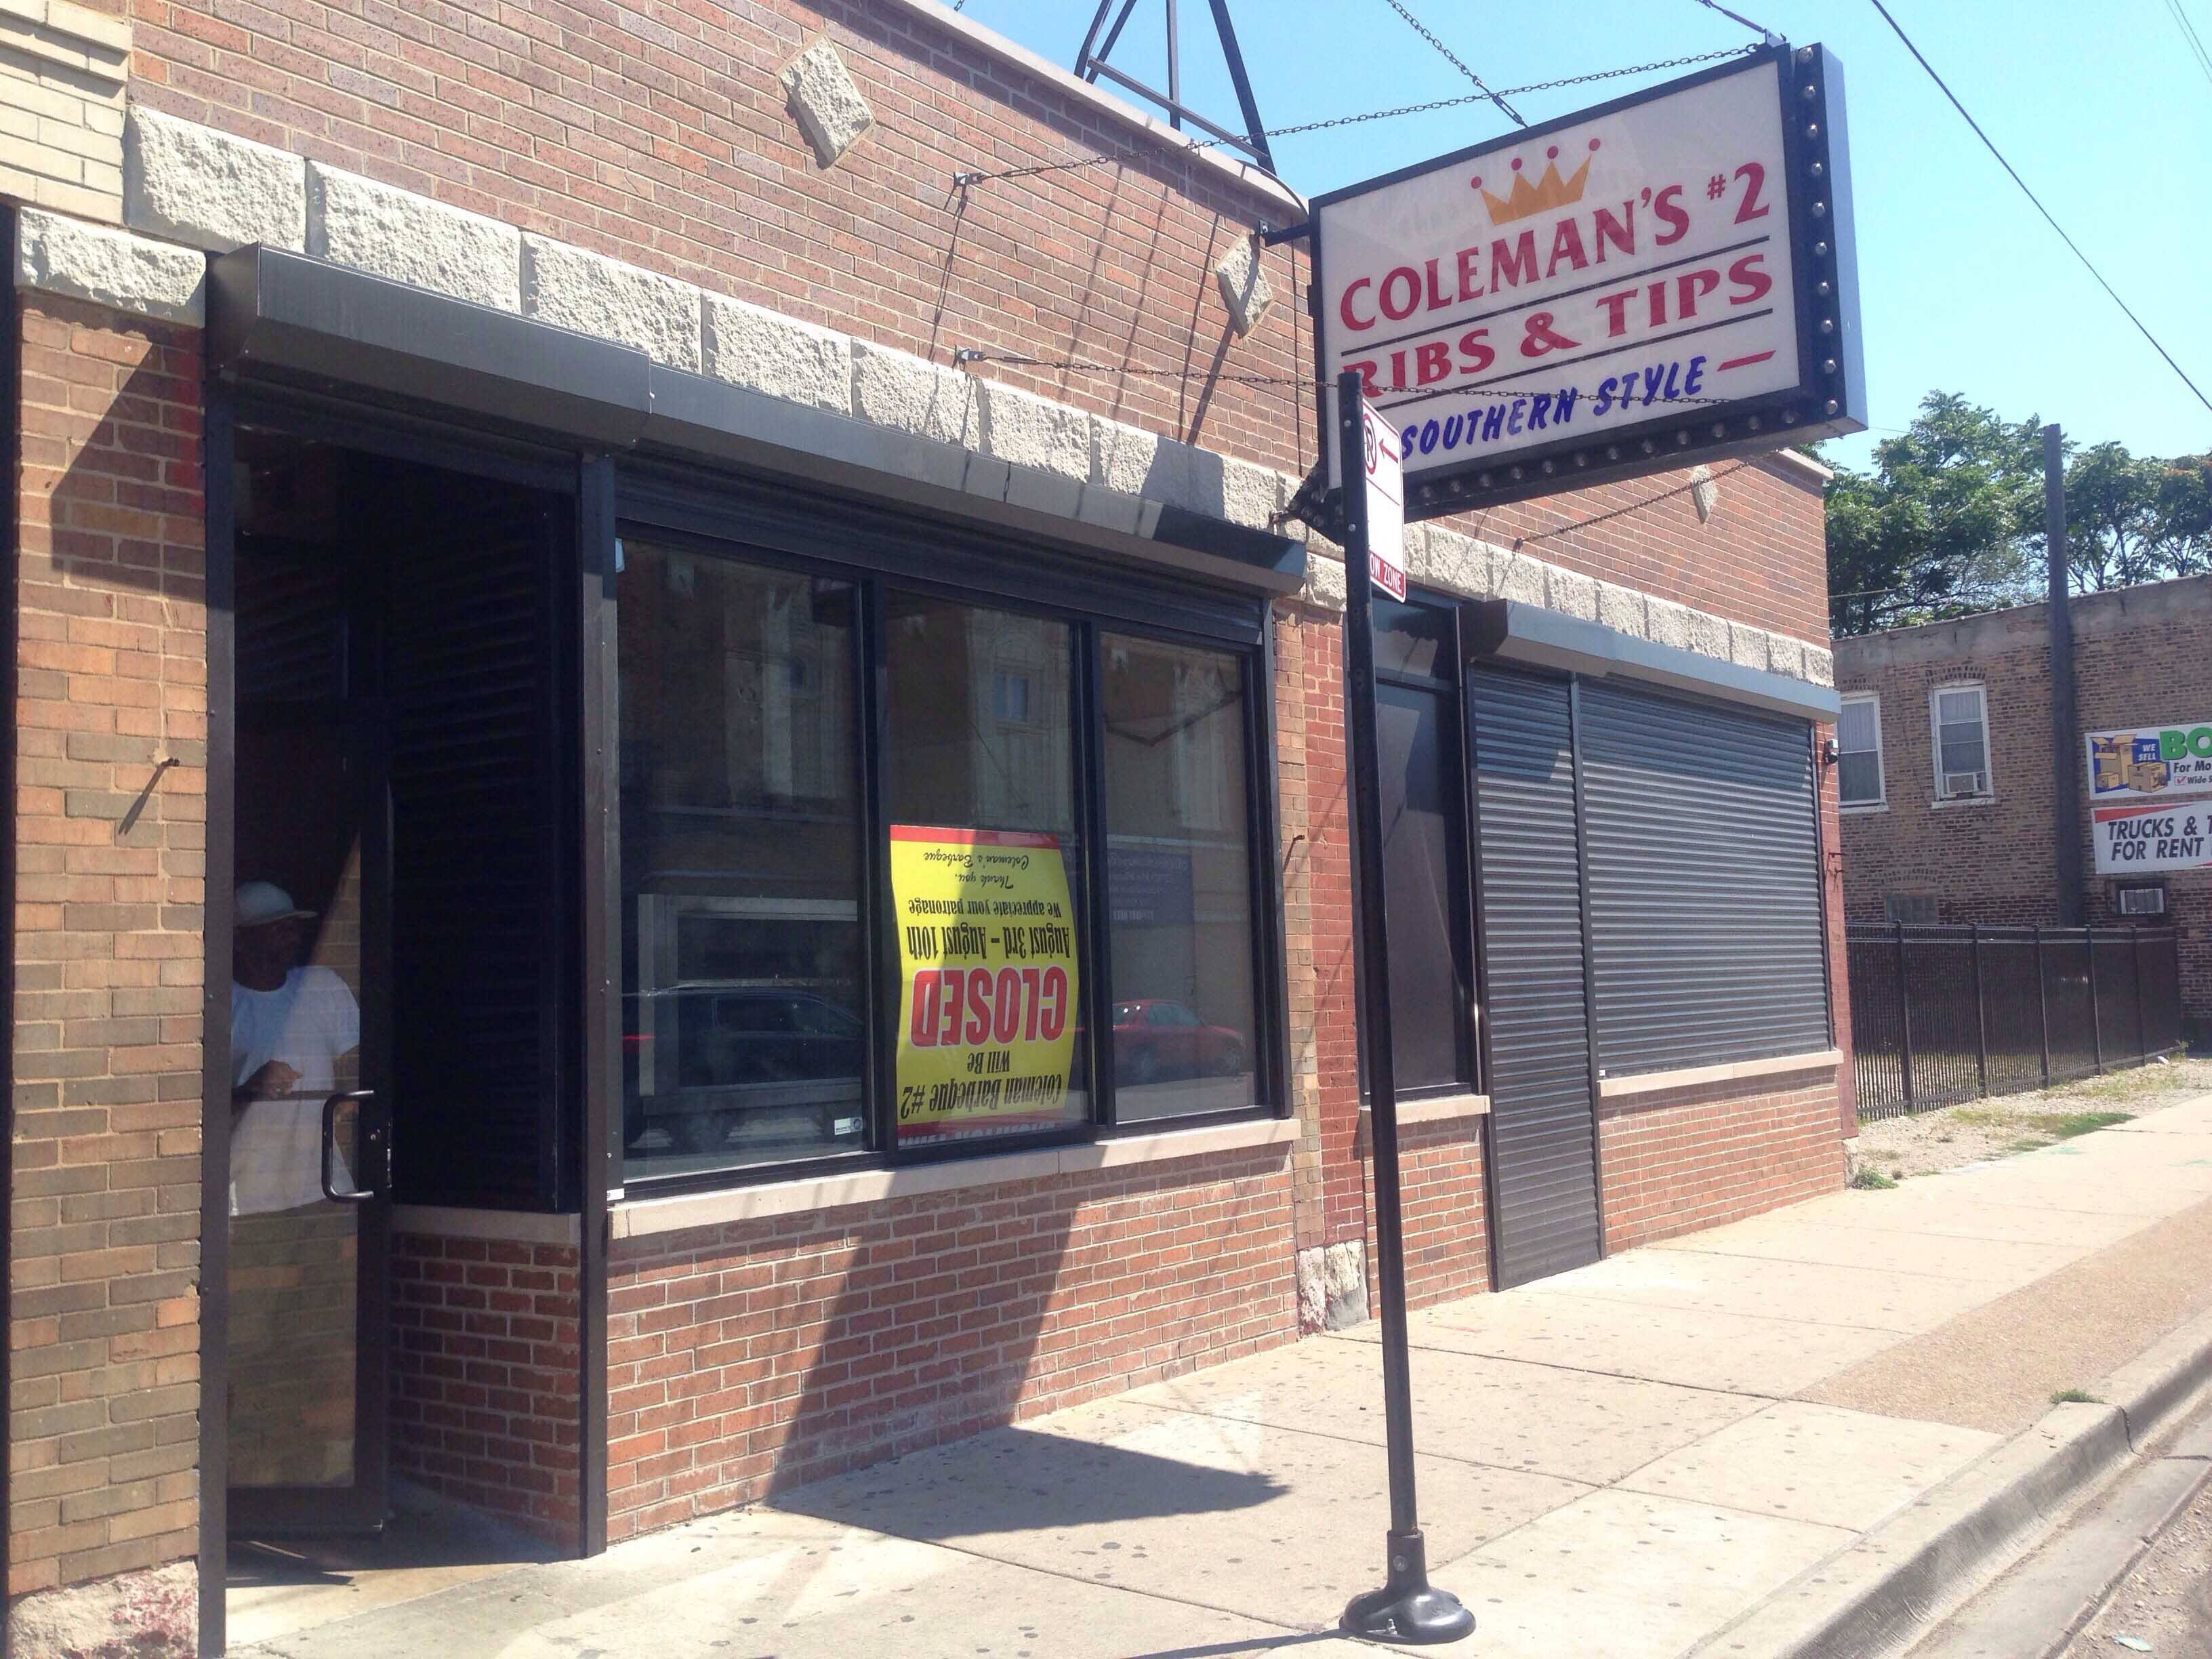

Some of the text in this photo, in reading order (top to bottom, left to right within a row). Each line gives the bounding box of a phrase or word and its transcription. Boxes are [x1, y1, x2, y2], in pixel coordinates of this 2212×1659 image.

[1340, 161, 1770, 330] COLEMAN'S #2
[1343, 254, 1773, 398] RIBS & TIPS
[1401, 356, 1706, 459] SOUTHERN STYLE
[1370, 553, 1403, 594] OW ZONE
[2138, 753, 2156, 761] SELL
[2142, 743, 2156, 752] WE
[2173, 762, 2191, 773] For
[2187, 775, 2207, 785] Wide
[2108, 817, 2174, 840] TRUCKS
[2184, 815, 2198, 836] &
[924, 848, 1029, 870] Coleman's Barbeque
[2111, 837, 2205, 861] FOR RENT
[981, 875, 1014, 889] Thank
[908, 897, 1062, 918] We appreciate your patronage
[907, 926, 939, 960] 10th
[942, 922, 987, 960] August
[1003, 926, 1025, 959] 3rd
[1030, 922, 1070, 958] August
[910, 966, 1068, 1047] CLOSED
[967, 1050, 1010, 1075] Will Be
[901, 1073, 1062, 1119] Coleman Barbeque #2
